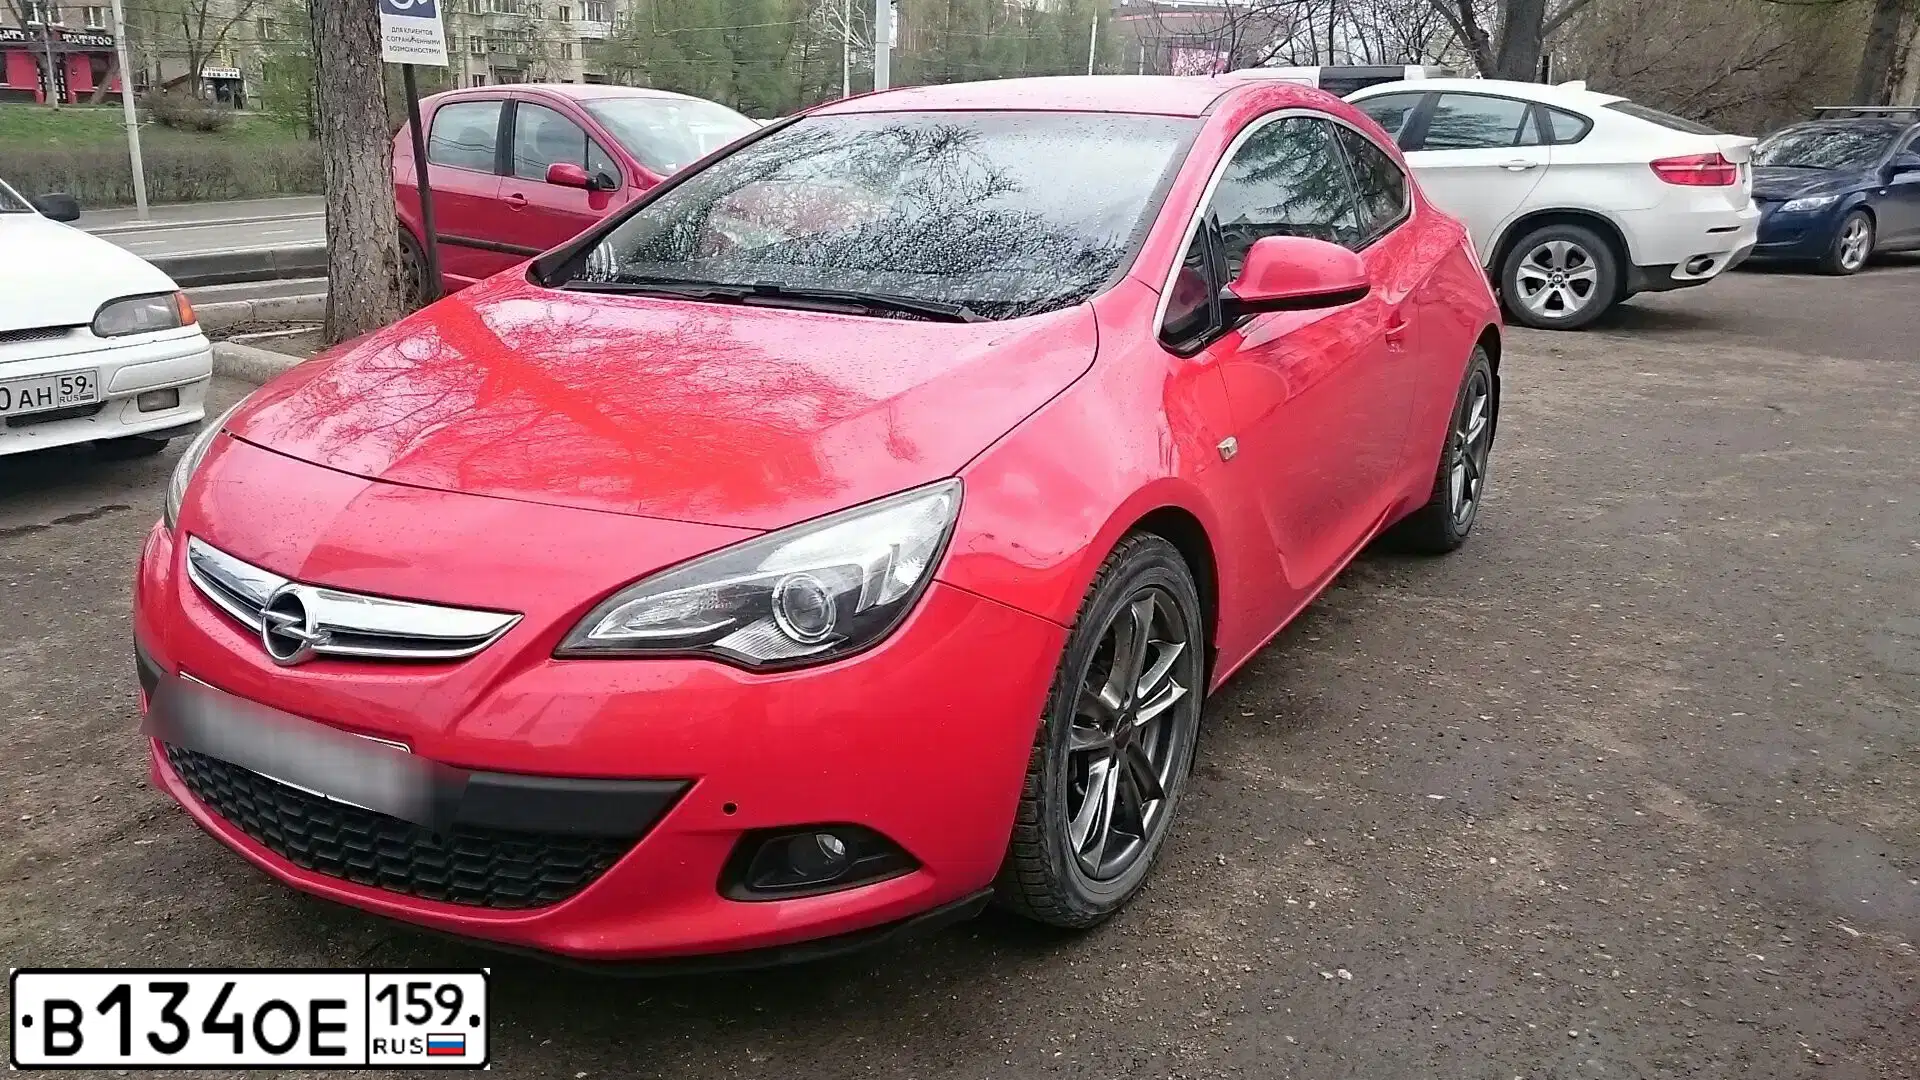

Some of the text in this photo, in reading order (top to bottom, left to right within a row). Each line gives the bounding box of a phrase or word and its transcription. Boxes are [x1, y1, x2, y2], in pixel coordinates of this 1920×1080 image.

[403, 27, 433, 36] КЛИЕНТОВ
[62, 33, 112, 46] TATTOO
[391, 36, 441, 45] ОГРАНИЧЕННЫМИ
[389, 45, 441, 54] ВОЗМОЖНОСТЯМИ
[60, 375, 87, 396] 59
[59, 394, 79, 403] RUS
